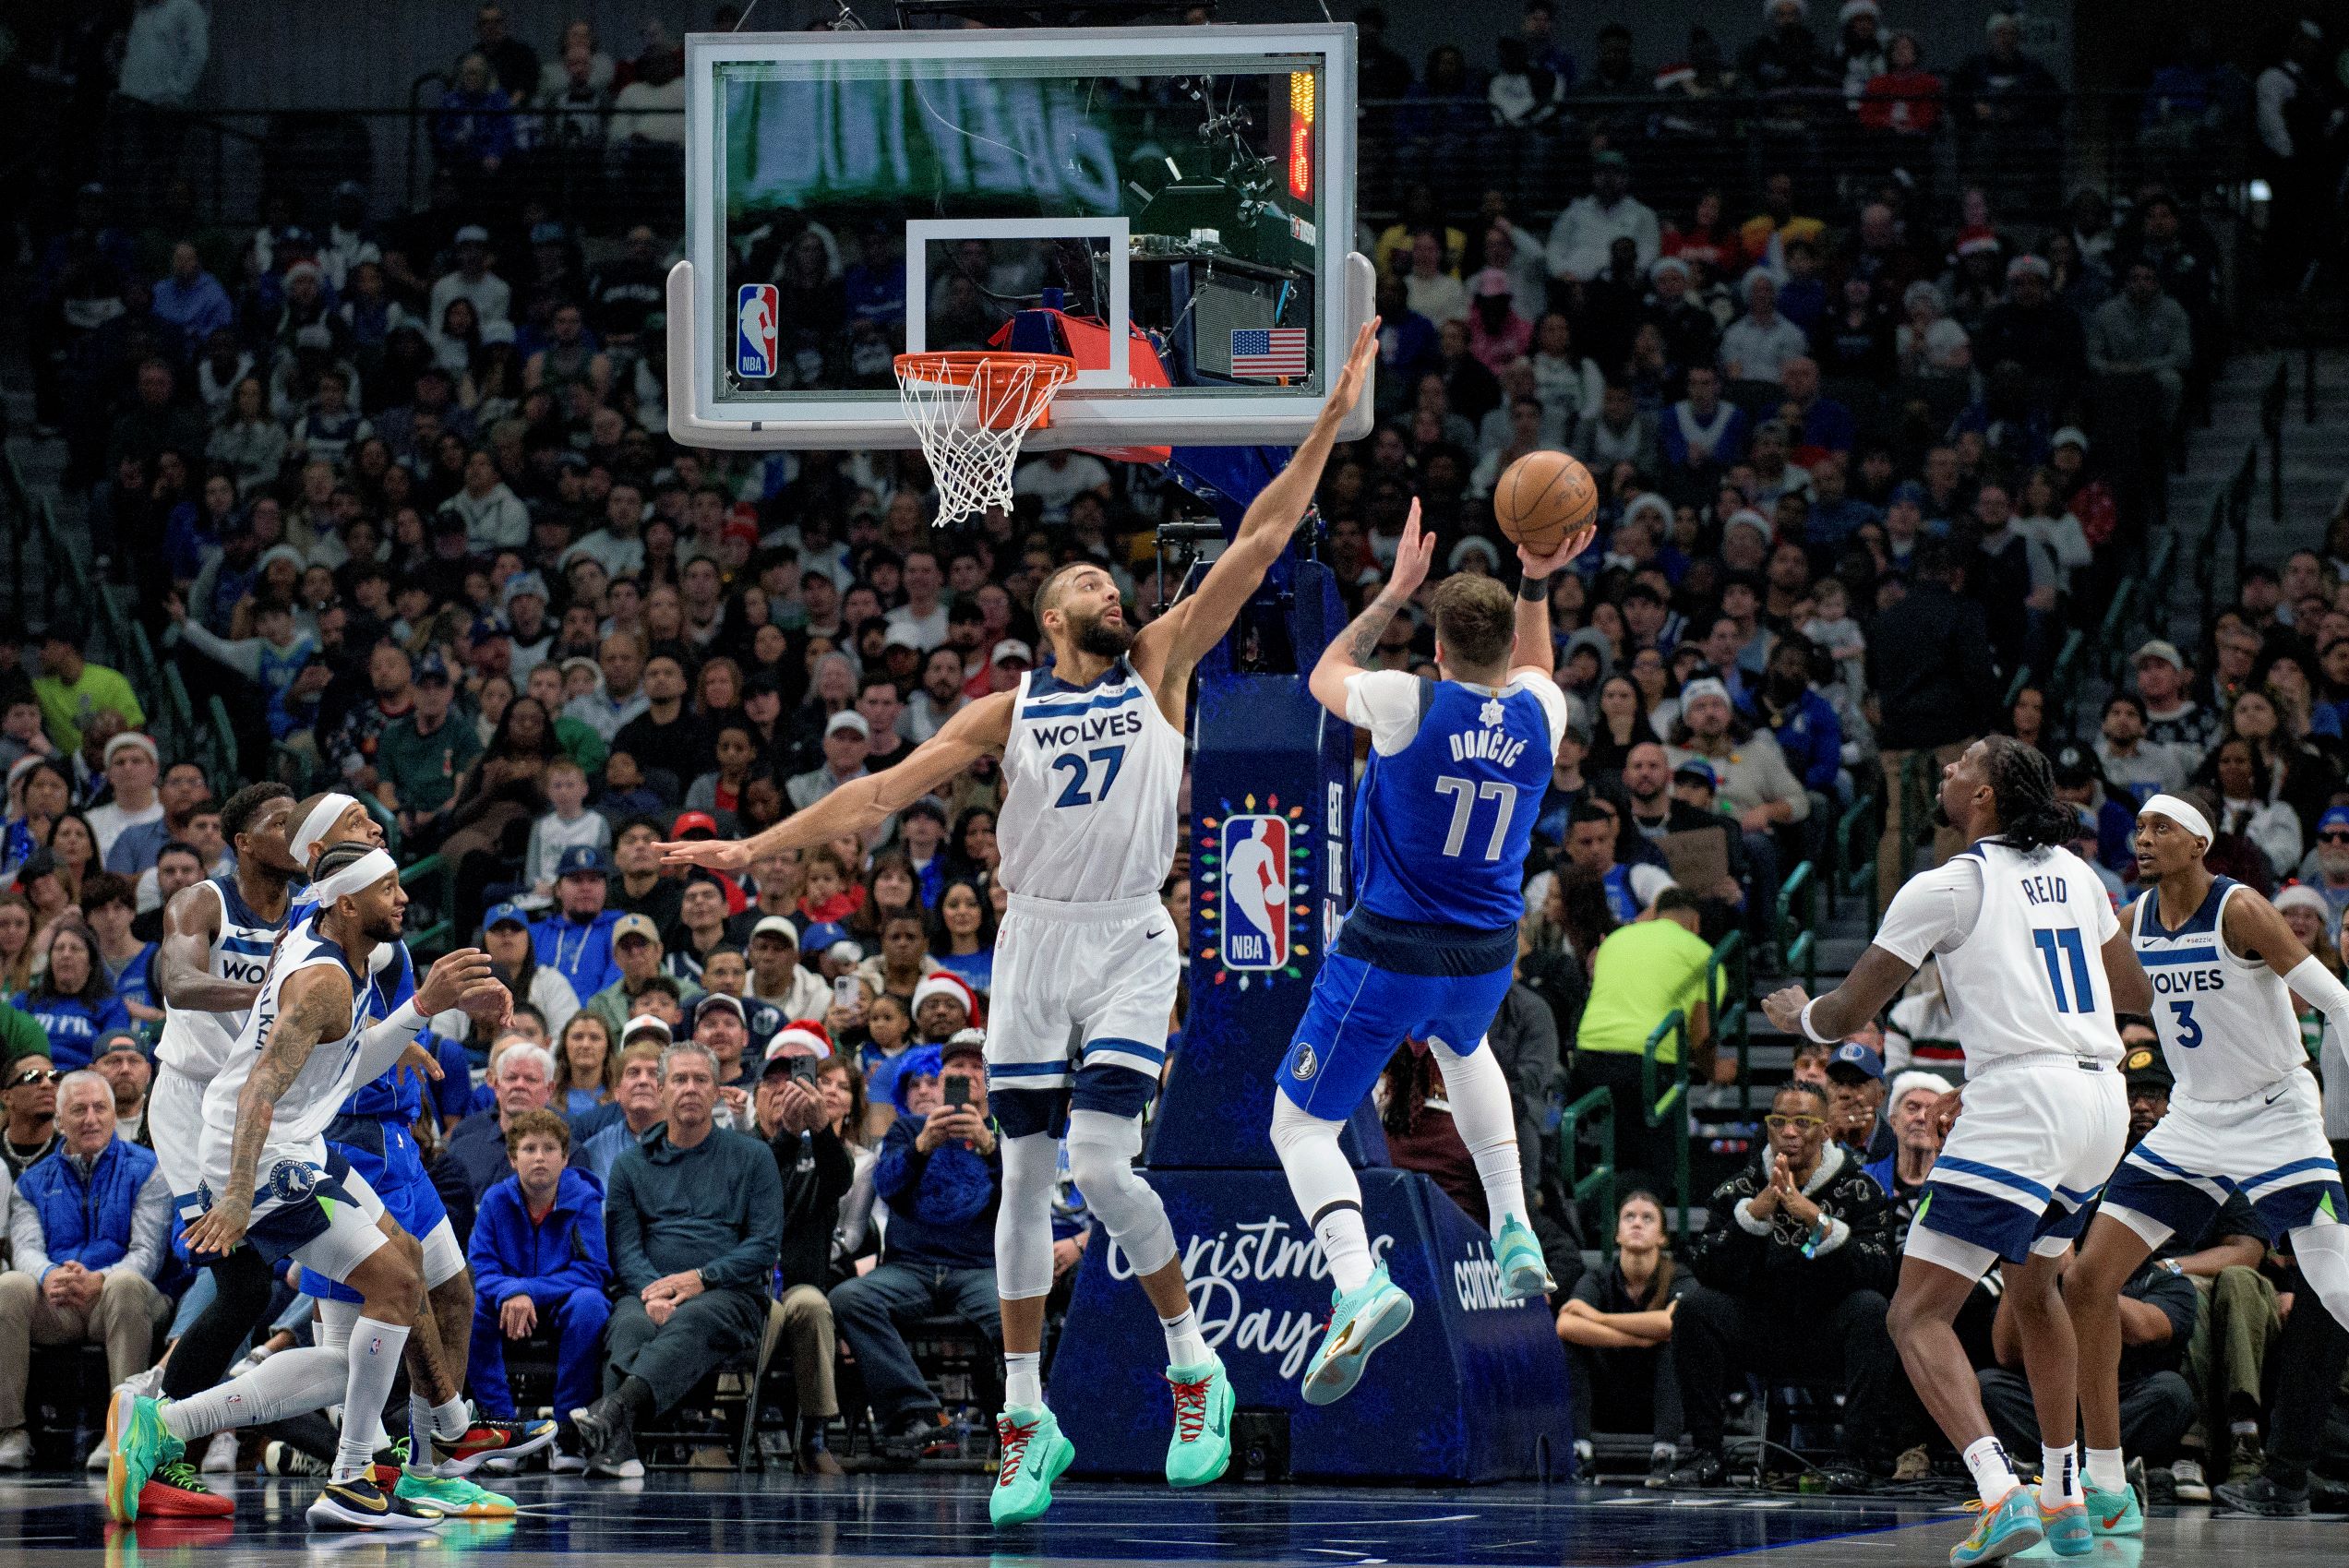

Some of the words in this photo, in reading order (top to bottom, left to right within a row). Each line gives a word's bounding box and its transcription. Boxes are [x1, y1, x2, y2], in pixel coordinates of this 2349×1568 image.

[742, 356, 762, 372] NBA
[1032, 711, 1142, 750] WOLVES
[1448, 726, 1528, 768] DONČIĆ
[1051, 745, 1126, 808] 27
[1434, 775, 1517, 861] 77
[1327, 840, 1343, 896] THE
[2020, 876, 2067, 905] REID
[1231, 935, 1264, 960] NBA
[2032, 927, 2096, 1013] 11
[2169, 999, 2203, 1048] 3
[1185, 1275, 1324, 1380] Day
